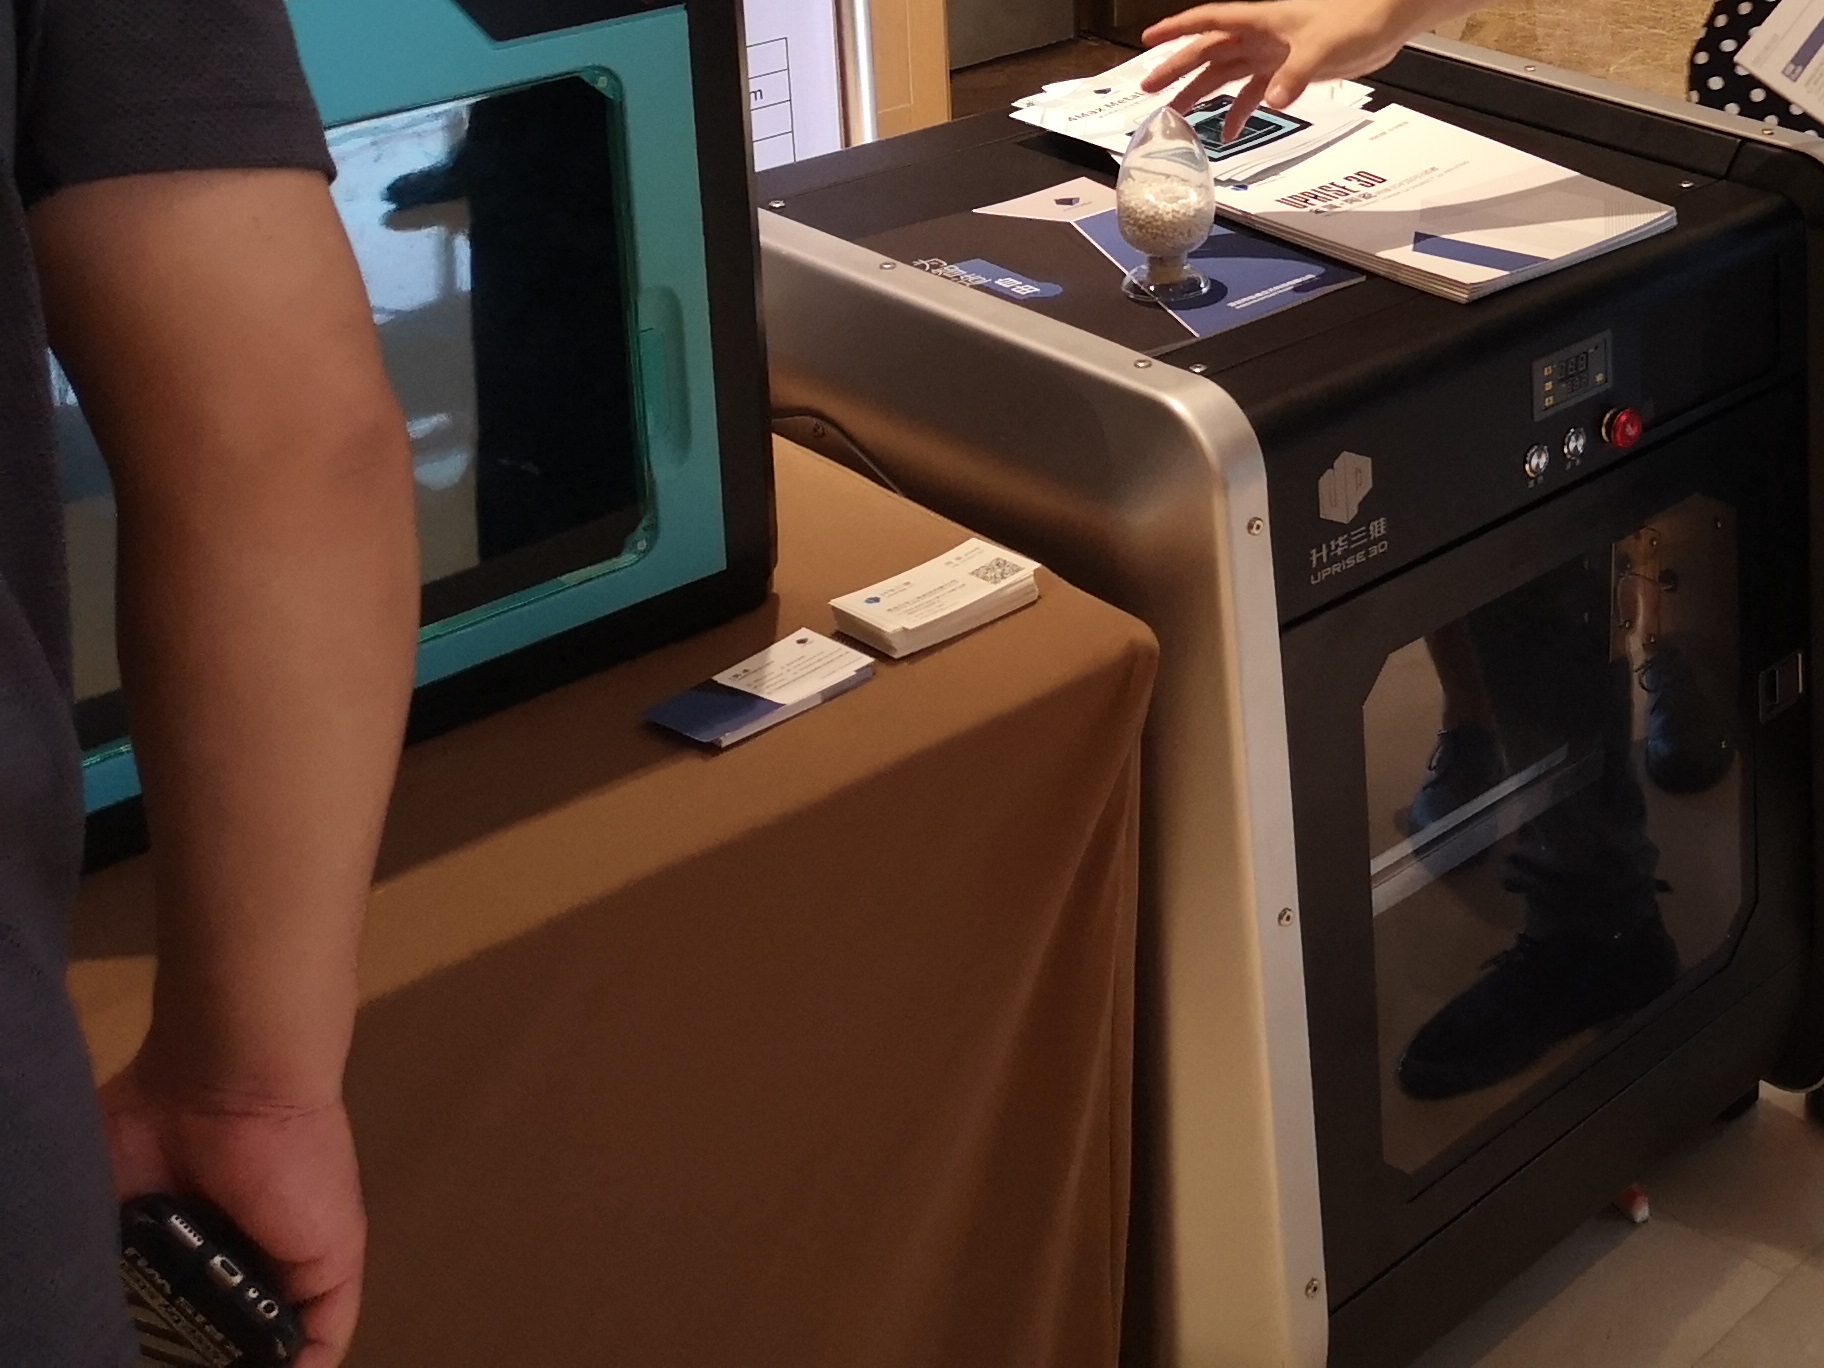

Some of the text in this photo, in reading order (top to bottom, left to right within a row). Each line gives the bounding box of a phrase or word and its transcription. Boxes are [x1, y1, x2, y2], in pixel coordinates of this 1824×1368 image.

[1274, 181, 1357, 210] UPRISE
[1343, 170, 1388, 188] 3D
[1310, 540, 1388, 585] UPRISE 3D
